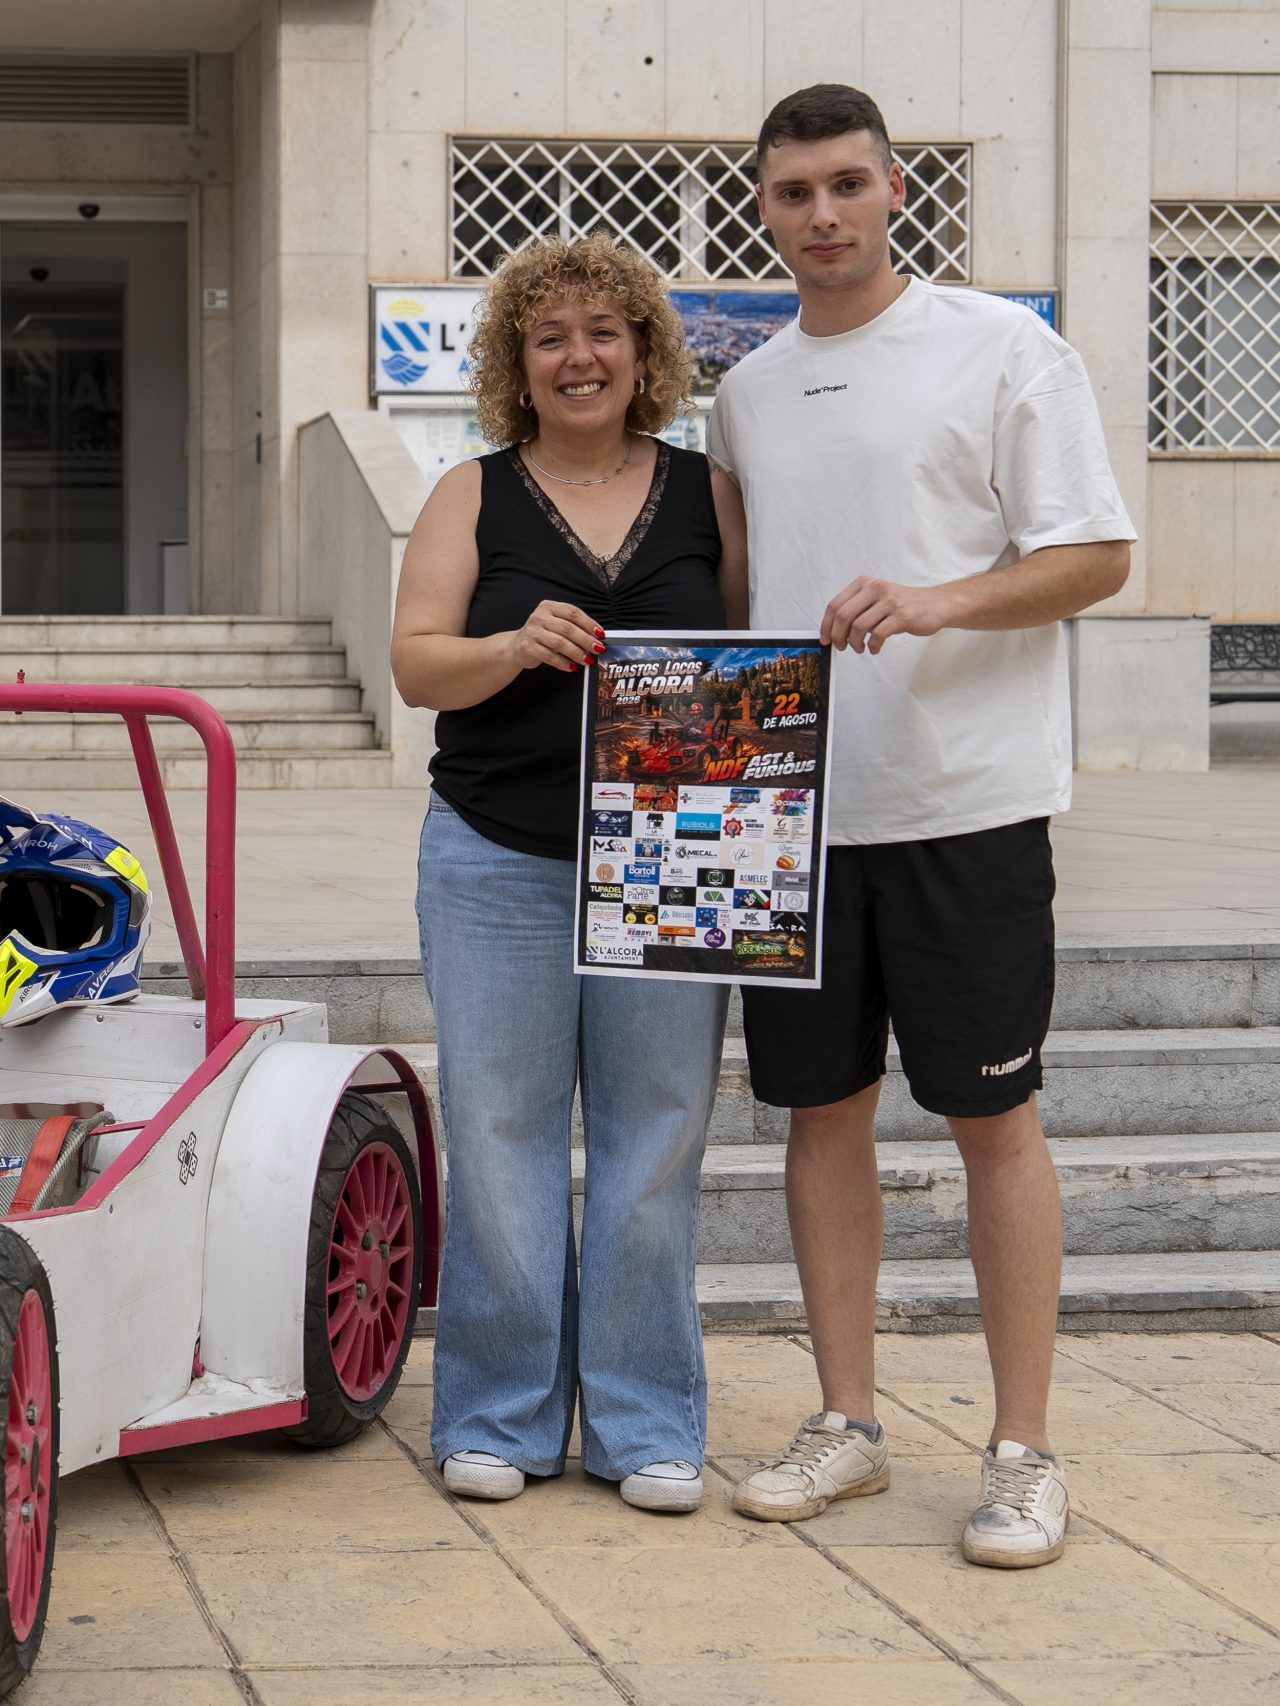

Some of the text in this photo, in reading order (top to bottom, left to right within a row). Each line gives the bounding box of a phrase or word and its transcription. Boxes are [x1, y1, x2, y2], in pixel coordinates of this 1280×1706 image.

[608, 661, 703, 679] TRASTOS LOCOS
[611, 675, 694, 698] ALCORA
[616, 696, 641, 706] 2026
[772, 693, 800, 716] 22
[762, 712, 817, 730] DE AGOSTO
[783, 751, 795, 763] &
[742, 759, 817, 781] FURIOUS
[739, 874, 768, 883] ASMELEC
[599, 946, 644, 957] L'ALCORA
